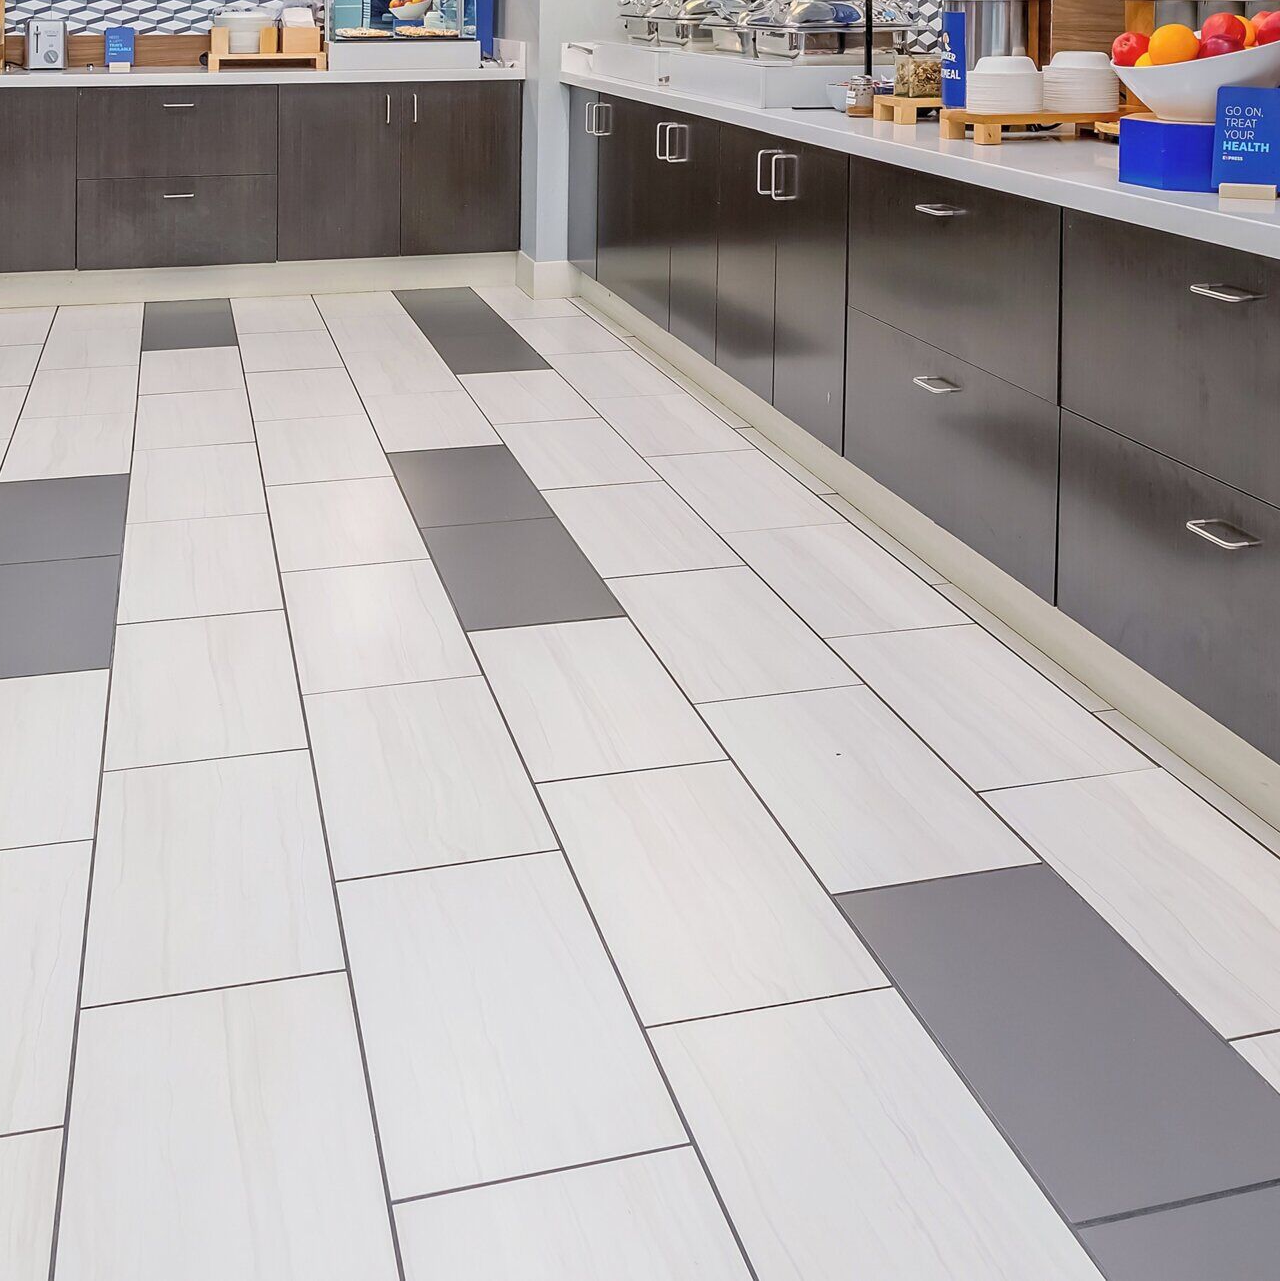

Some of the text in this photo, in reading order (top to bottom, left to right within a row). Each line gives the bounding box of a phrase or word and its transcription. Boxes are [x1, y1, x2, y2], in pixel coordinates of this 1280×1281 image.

[1225, 106, 1242, 116] GO
[1225, 118, 1258, 128] TREAT
[1224, 130, 1255, 140] YOUR
[1222, 141, 1270, 153] HEALTH
